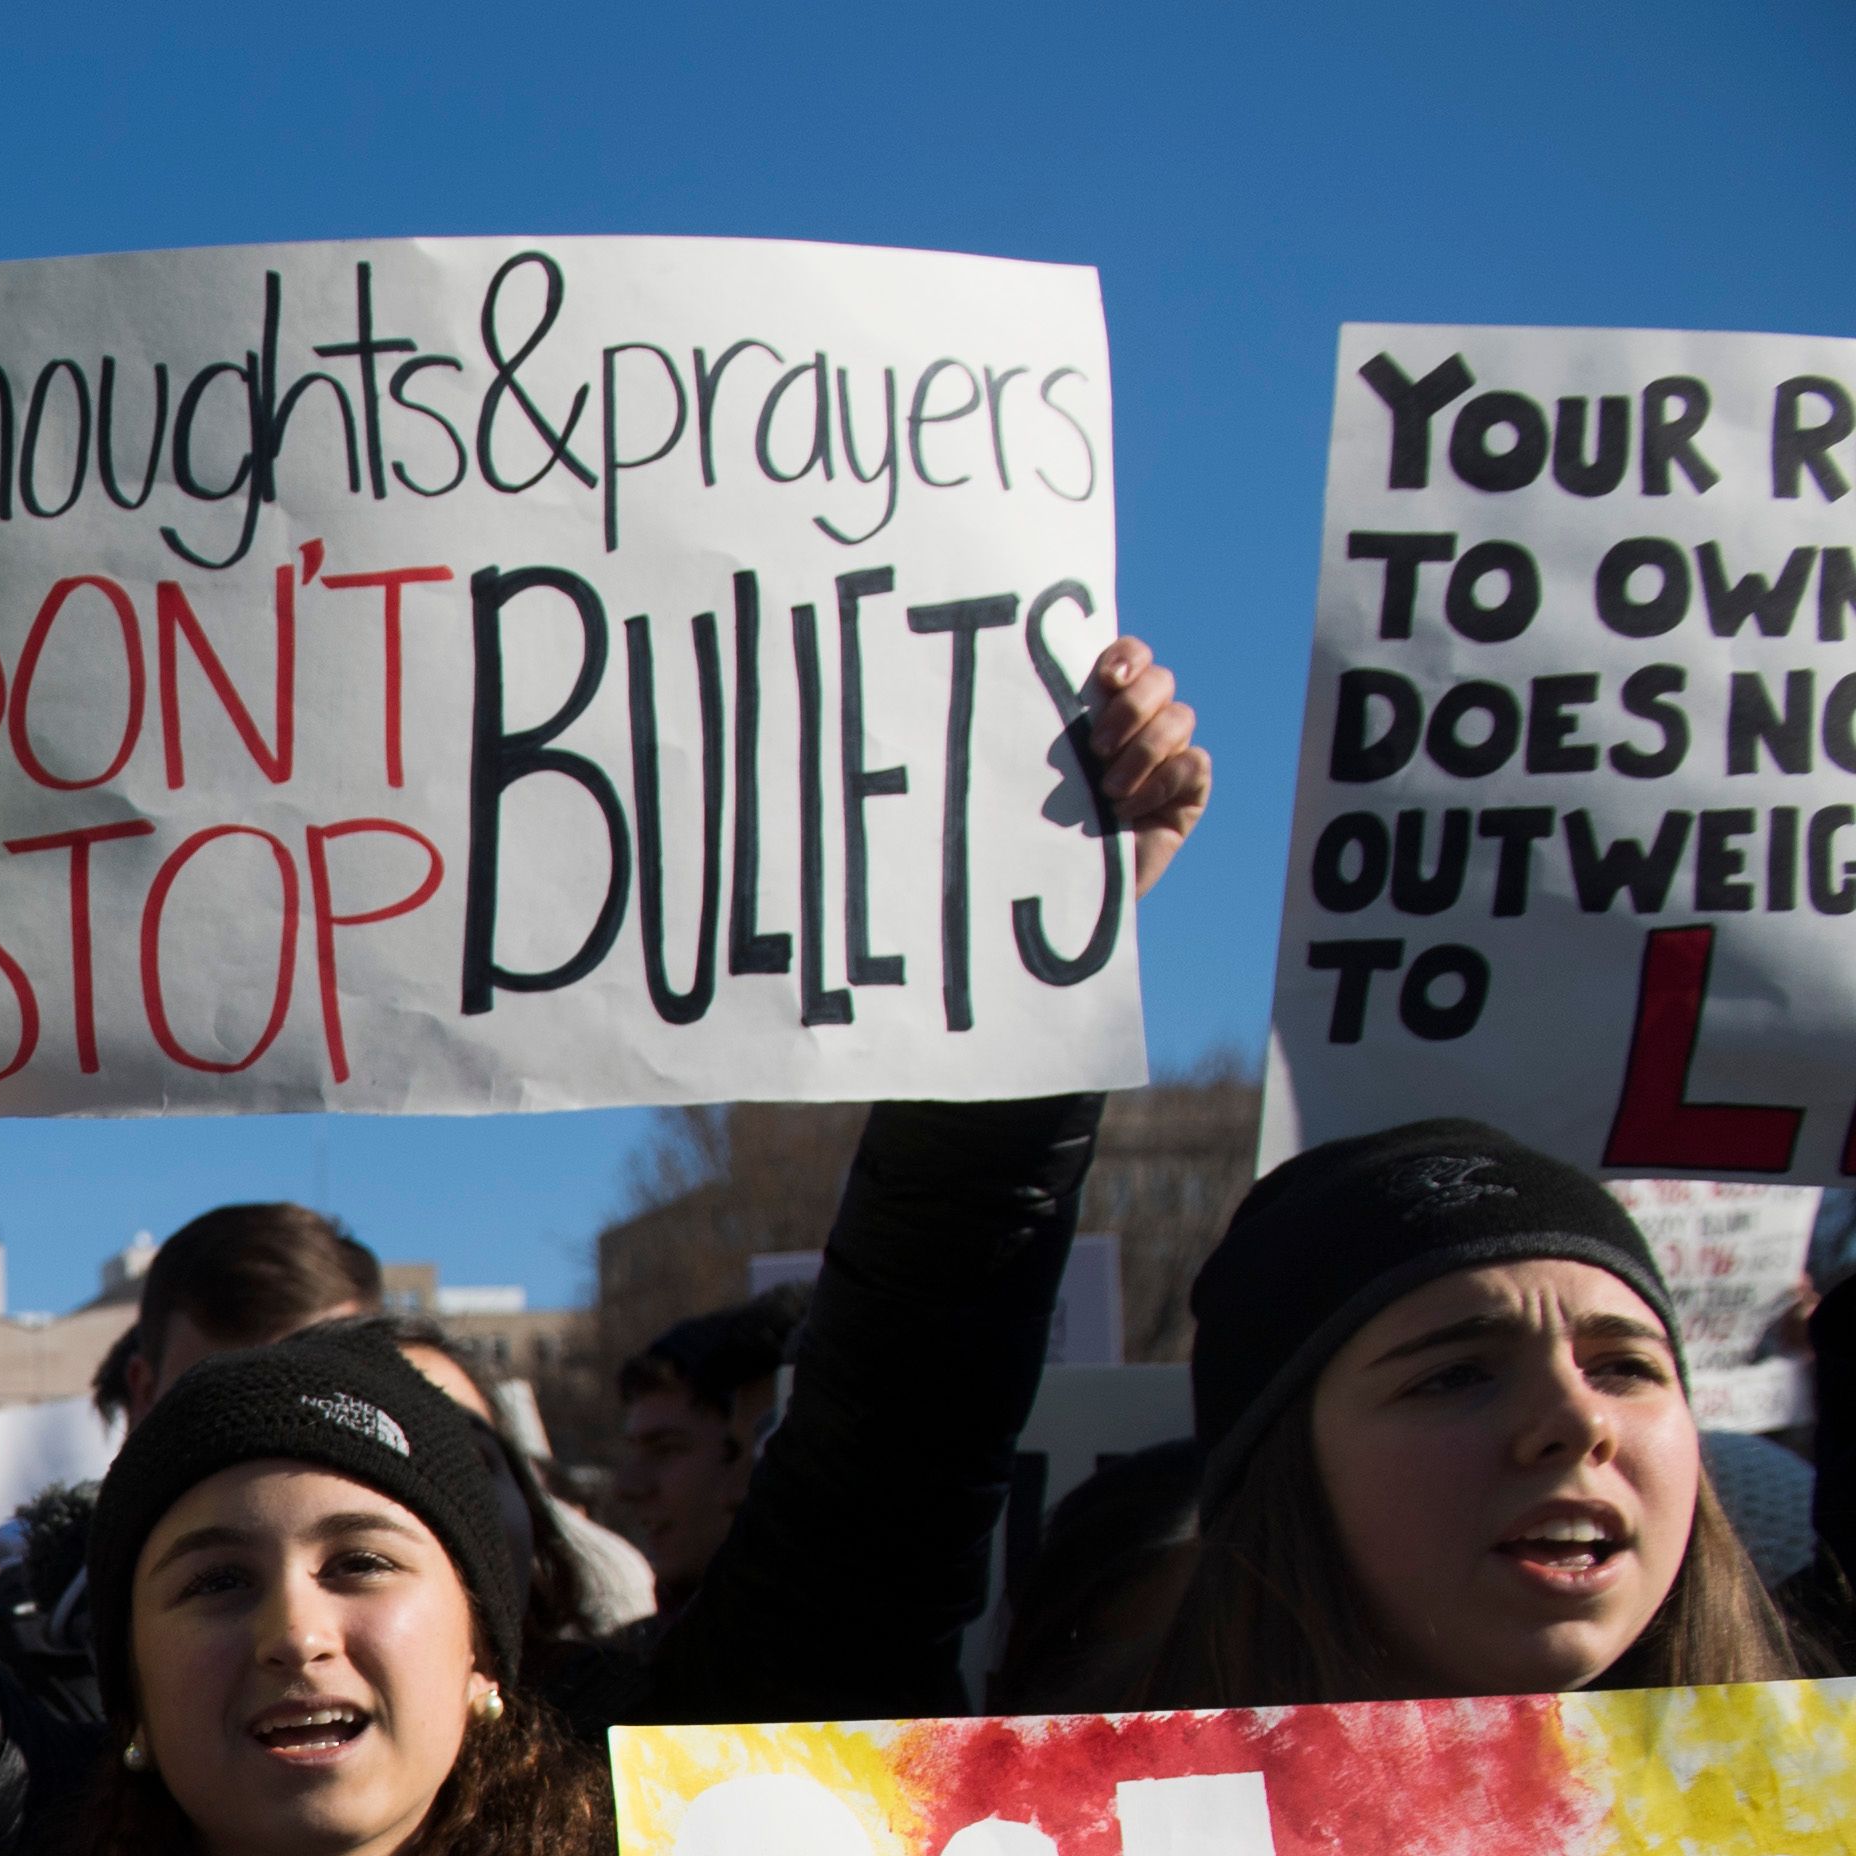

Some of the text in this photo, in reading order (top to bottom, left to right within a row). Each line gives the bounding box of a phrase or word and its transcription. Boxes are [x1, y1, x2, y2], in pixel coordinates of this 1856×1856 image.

[1359, 351, 1720, 494] YOUR
[1347, 531, 1540, 643] TO
[1328, 662, 1689, 782] DOES
[461, 563, 1127, 1032] BULLETS
[1305, 937, 1491, 1044] TO
